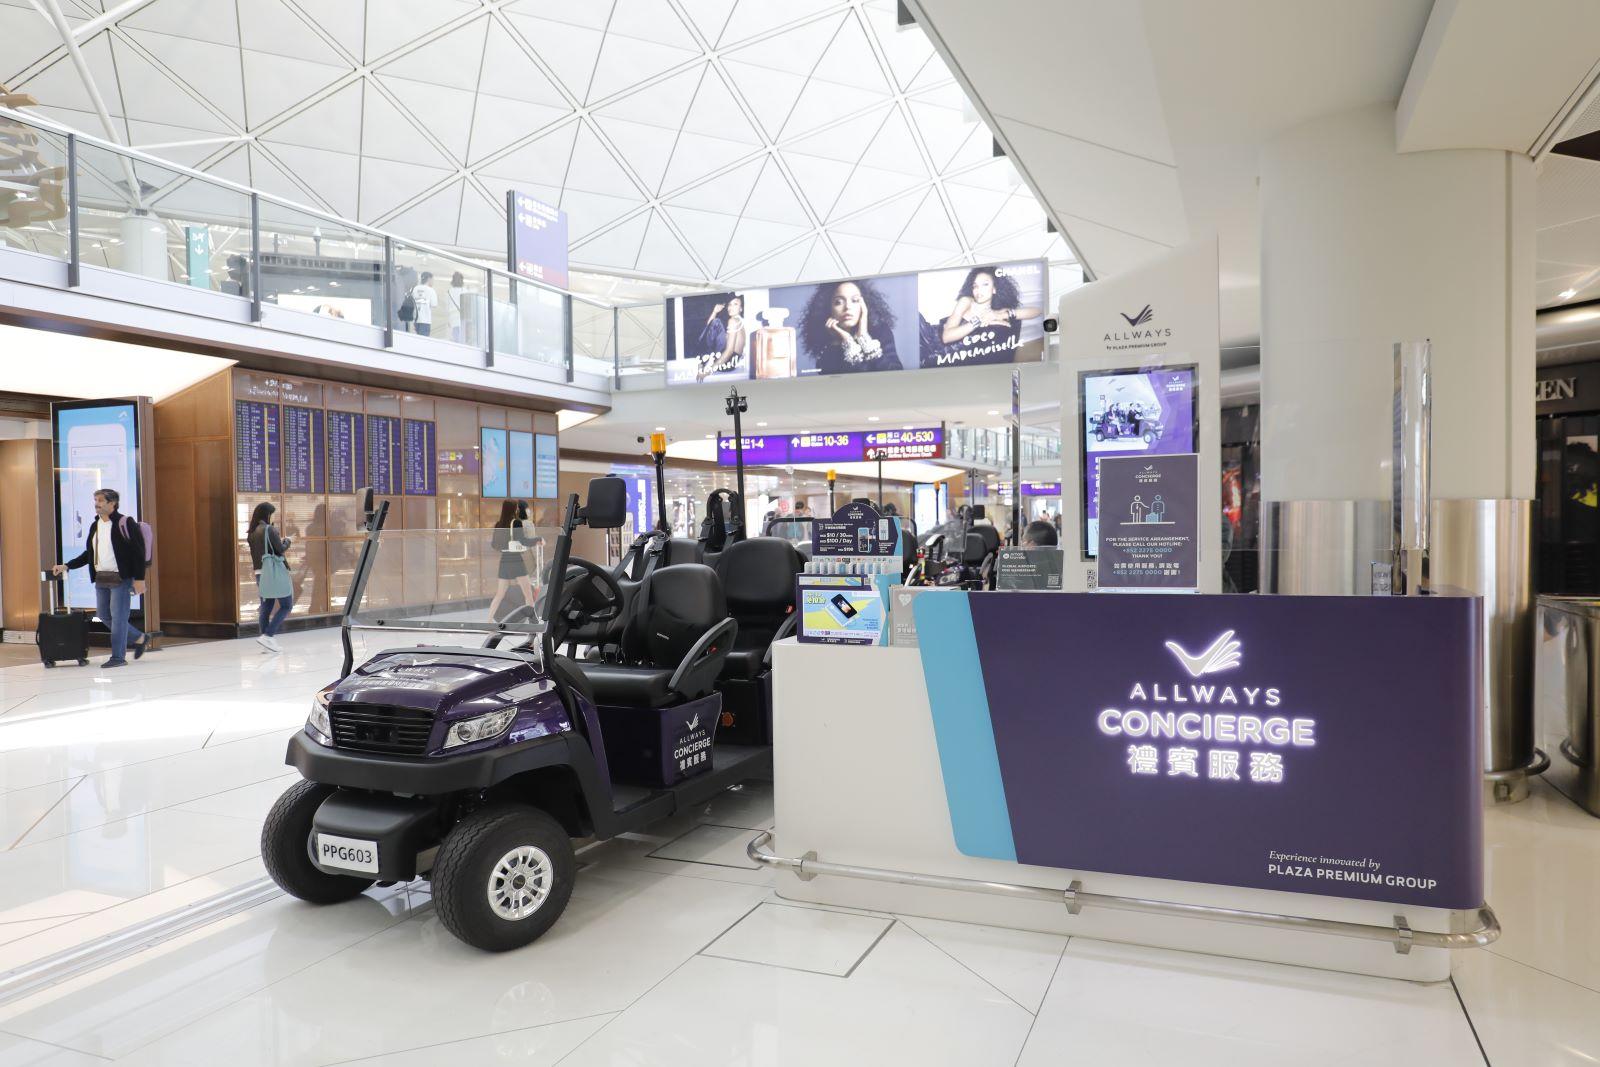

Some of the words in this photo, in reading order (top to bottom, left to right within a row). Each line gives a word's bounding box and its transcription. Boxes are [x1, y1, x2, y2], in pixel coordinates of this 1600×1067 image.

[1103, 328, 1172, 341] ALLWAYS
[750, 438, 765, 449] 1-4
[823, 434, 849, 446] 10-36
[900, 430, 935, 443] 40-530
[1129, 683, 1281, 706] ALLWAYS
[679, 729, 706, 744] ALLWAYS
[1097, 709, 1316, 747] CONCIERGE
[674, 736, 711, 760] CONCIERGE
[1127, 744, 1284, 783] 禮賓服務
[322, 843, 373, 864] PPG603
[1269, 850, 1318, 864] Experience
[1319, 855, 1367, 868] innovated
[1368, 858, 1381, 871] by
[1268, 863, 1313, 878] PLAZA
[1316, 868, 1382, 885] PREMIUM
[1385, 875, 1437, 890] GROUP
